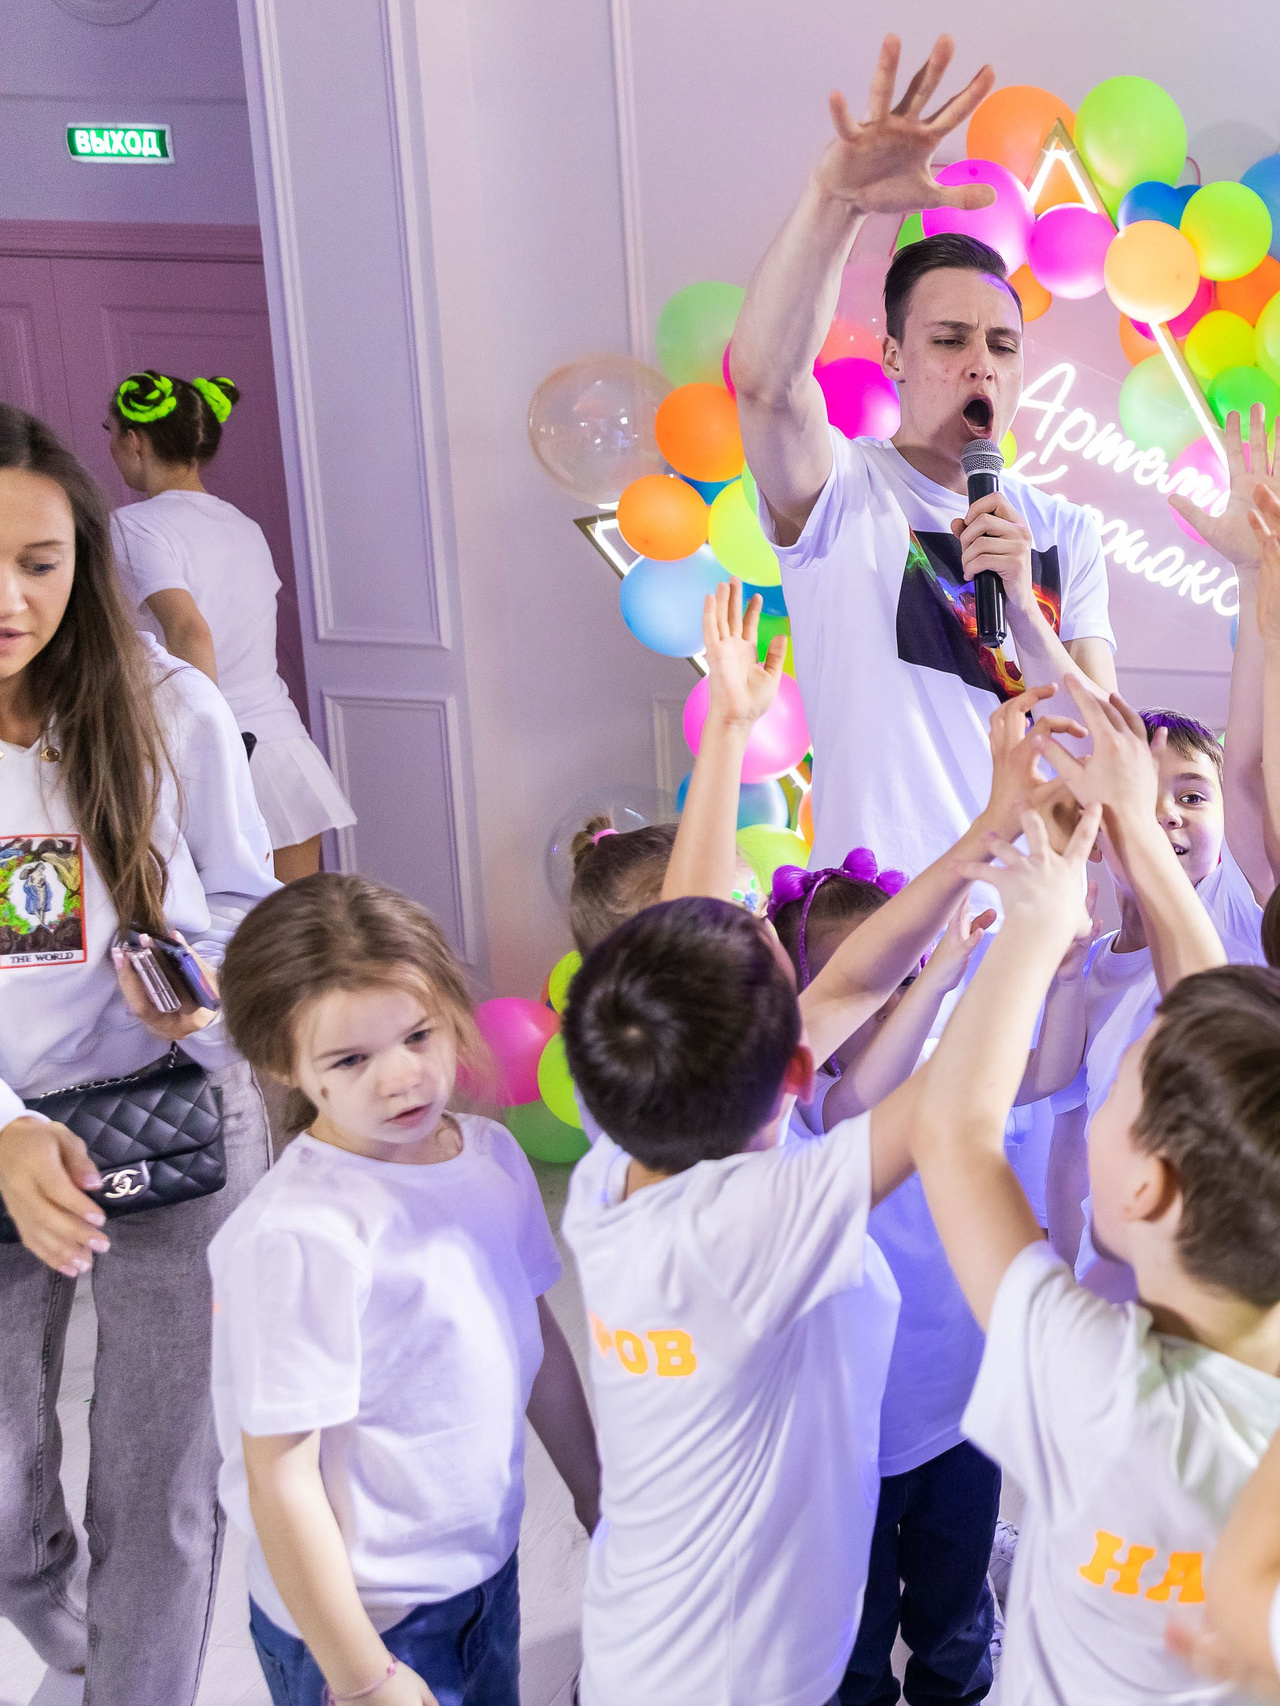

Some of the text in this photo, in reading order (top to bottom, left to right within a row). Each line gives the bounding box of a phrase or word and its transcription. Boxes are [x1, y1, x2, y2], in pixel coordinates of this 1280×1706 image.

[74, 129, 162, 157] ВЫХОД
[11, 951, 74, 964] THE WORLD
